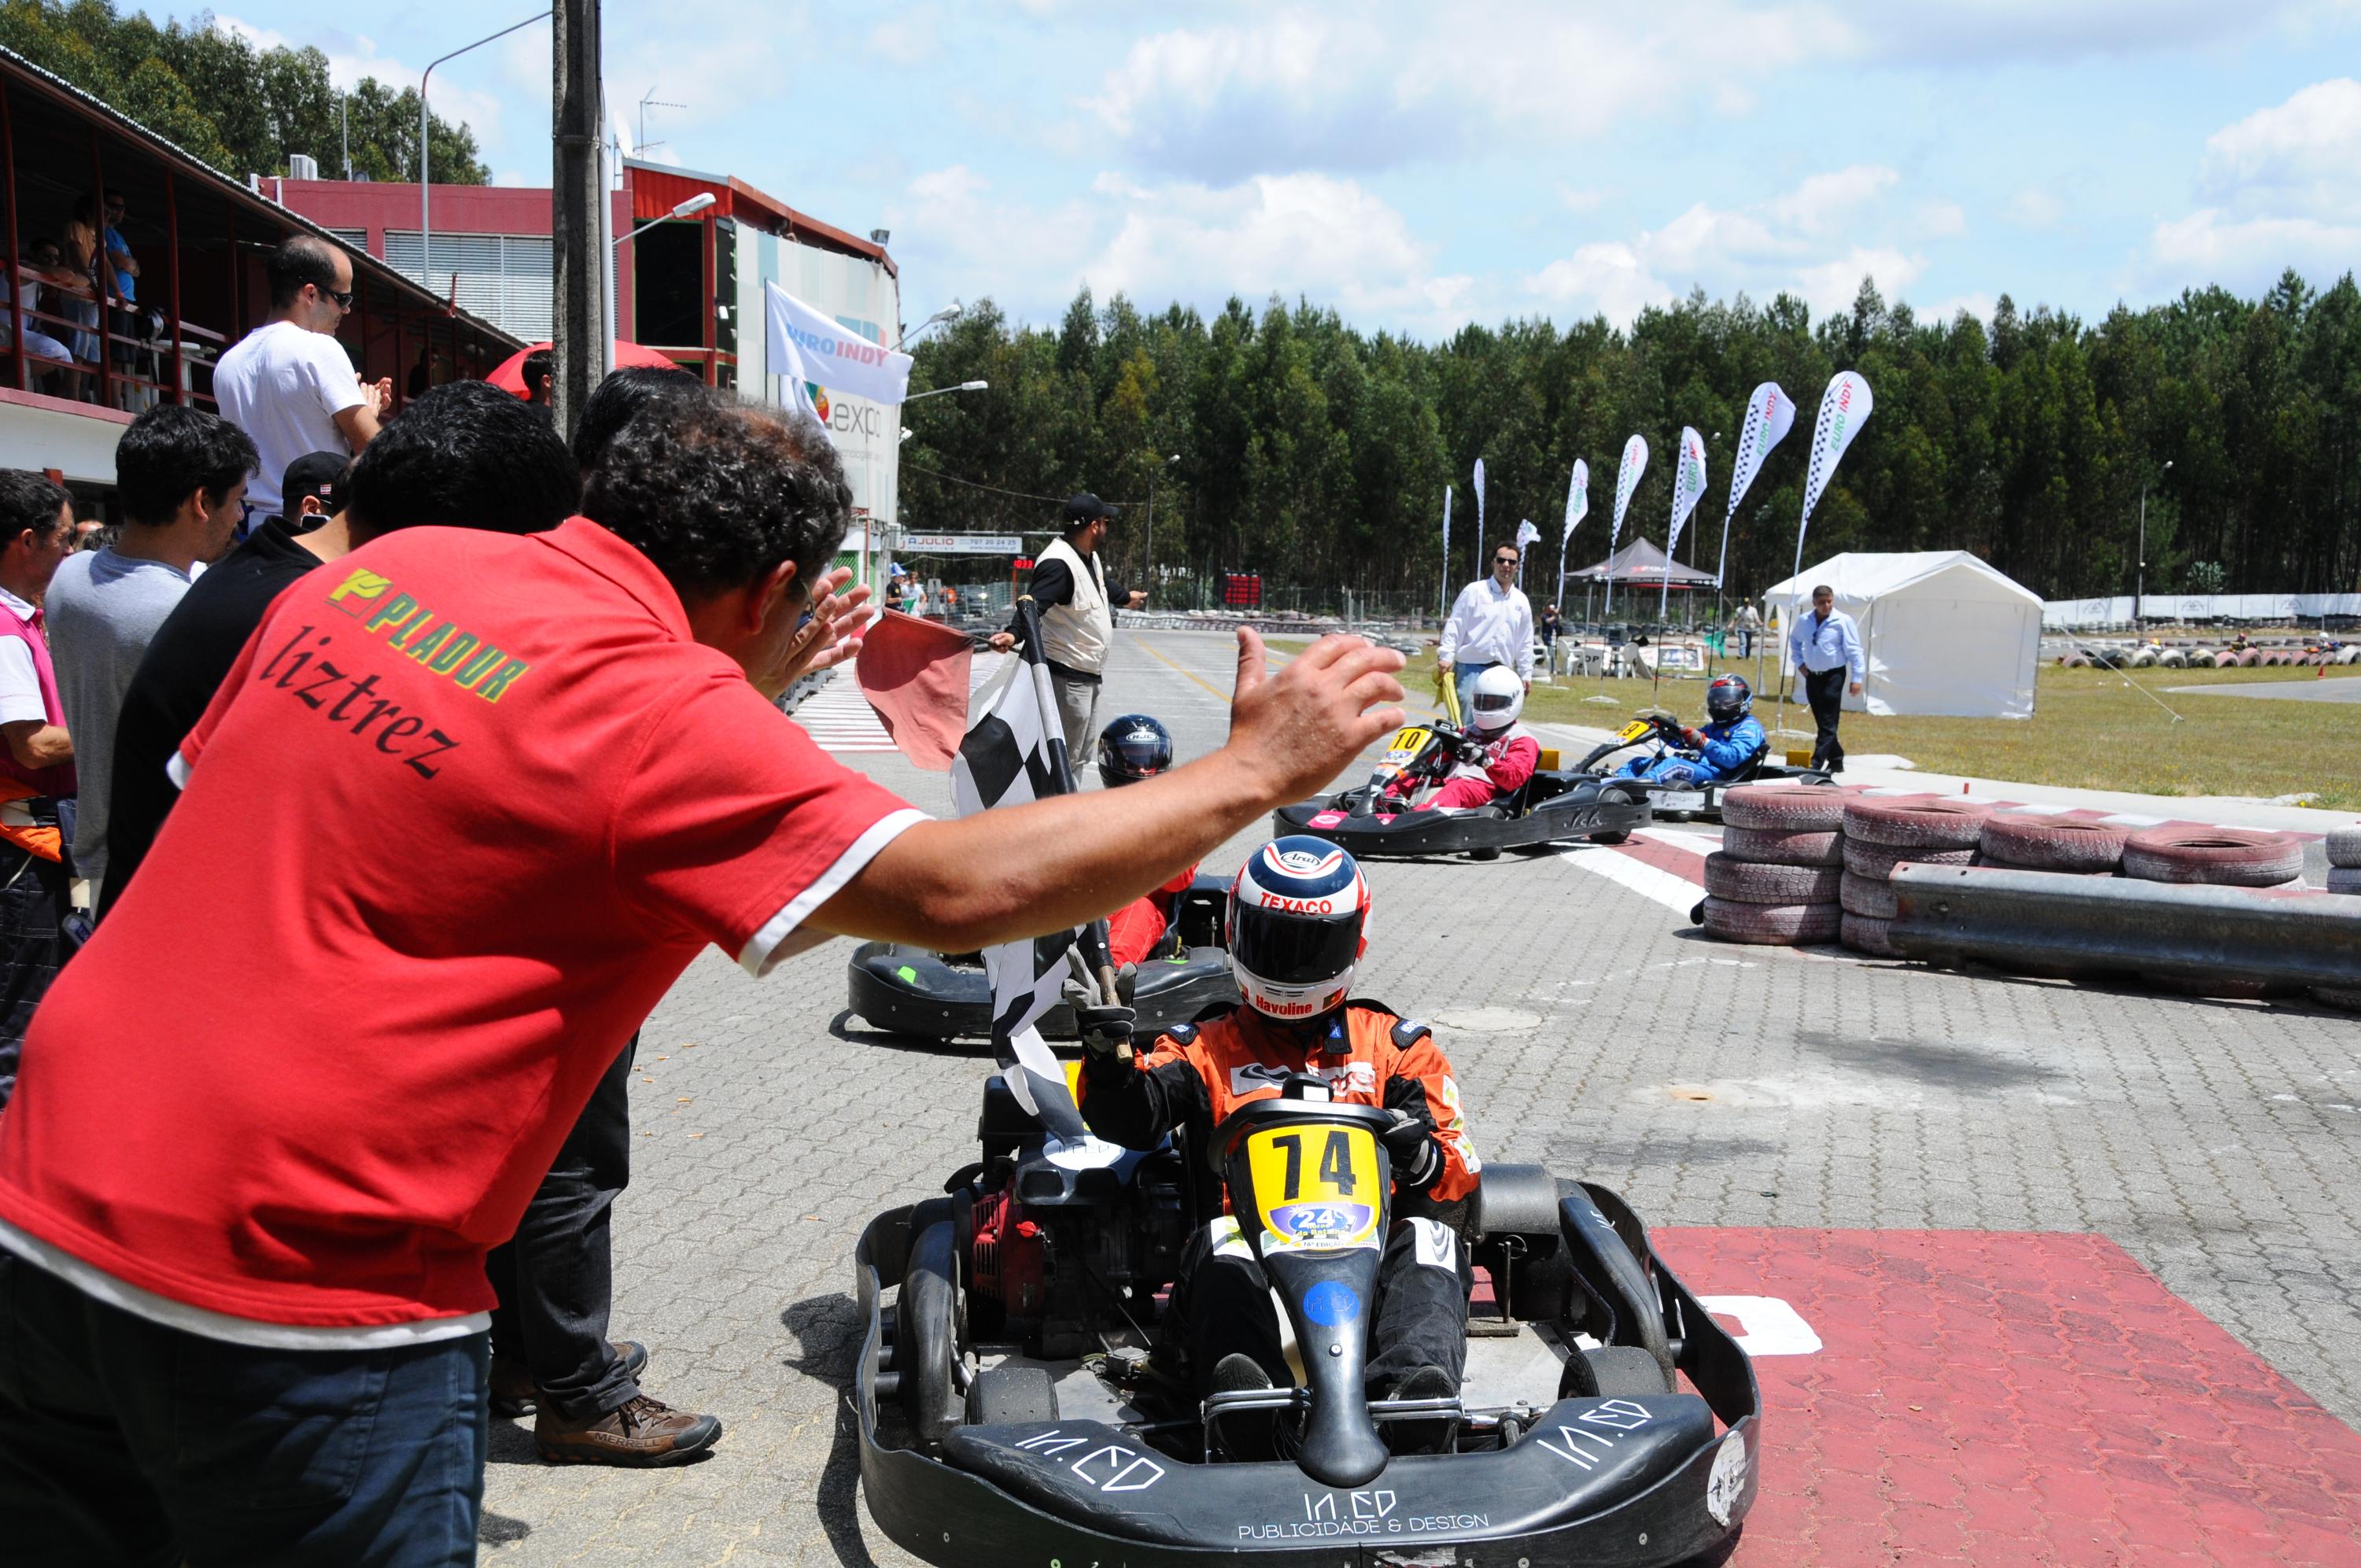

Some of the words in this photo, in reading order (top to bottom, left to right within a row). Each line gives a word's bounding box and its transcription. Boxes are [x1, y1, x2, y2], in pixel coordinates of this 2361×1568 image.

[1756, 423, 1770, 456] EURO
[1765, 391, 1776, 422] INDY
[1830, 414, 1846, 452] EURO
[1839, 381, 1853, 413] INDY
[1687, 462, 1699, 493] EURO
[1573, 488, 1584, 514] EURO
[365, 592, 529, 704] PLADUR
[259, 625, 461, 780] liztrez
[1393, 731, 1422, 750] 10
[1290, 853, 1316, 864] Arai
[1260, 891, 1332, 916] TEXACO
[1256, 994, 1312, 1016] Havoline
[595, 1433, 659, 1448] MERRELL
[1238, 1520, 1382, 1540] PUBLICIDADE
[1388, 1519, 1402, 1533] &
[1409, 1514, 1490, 1532] DESIGN
